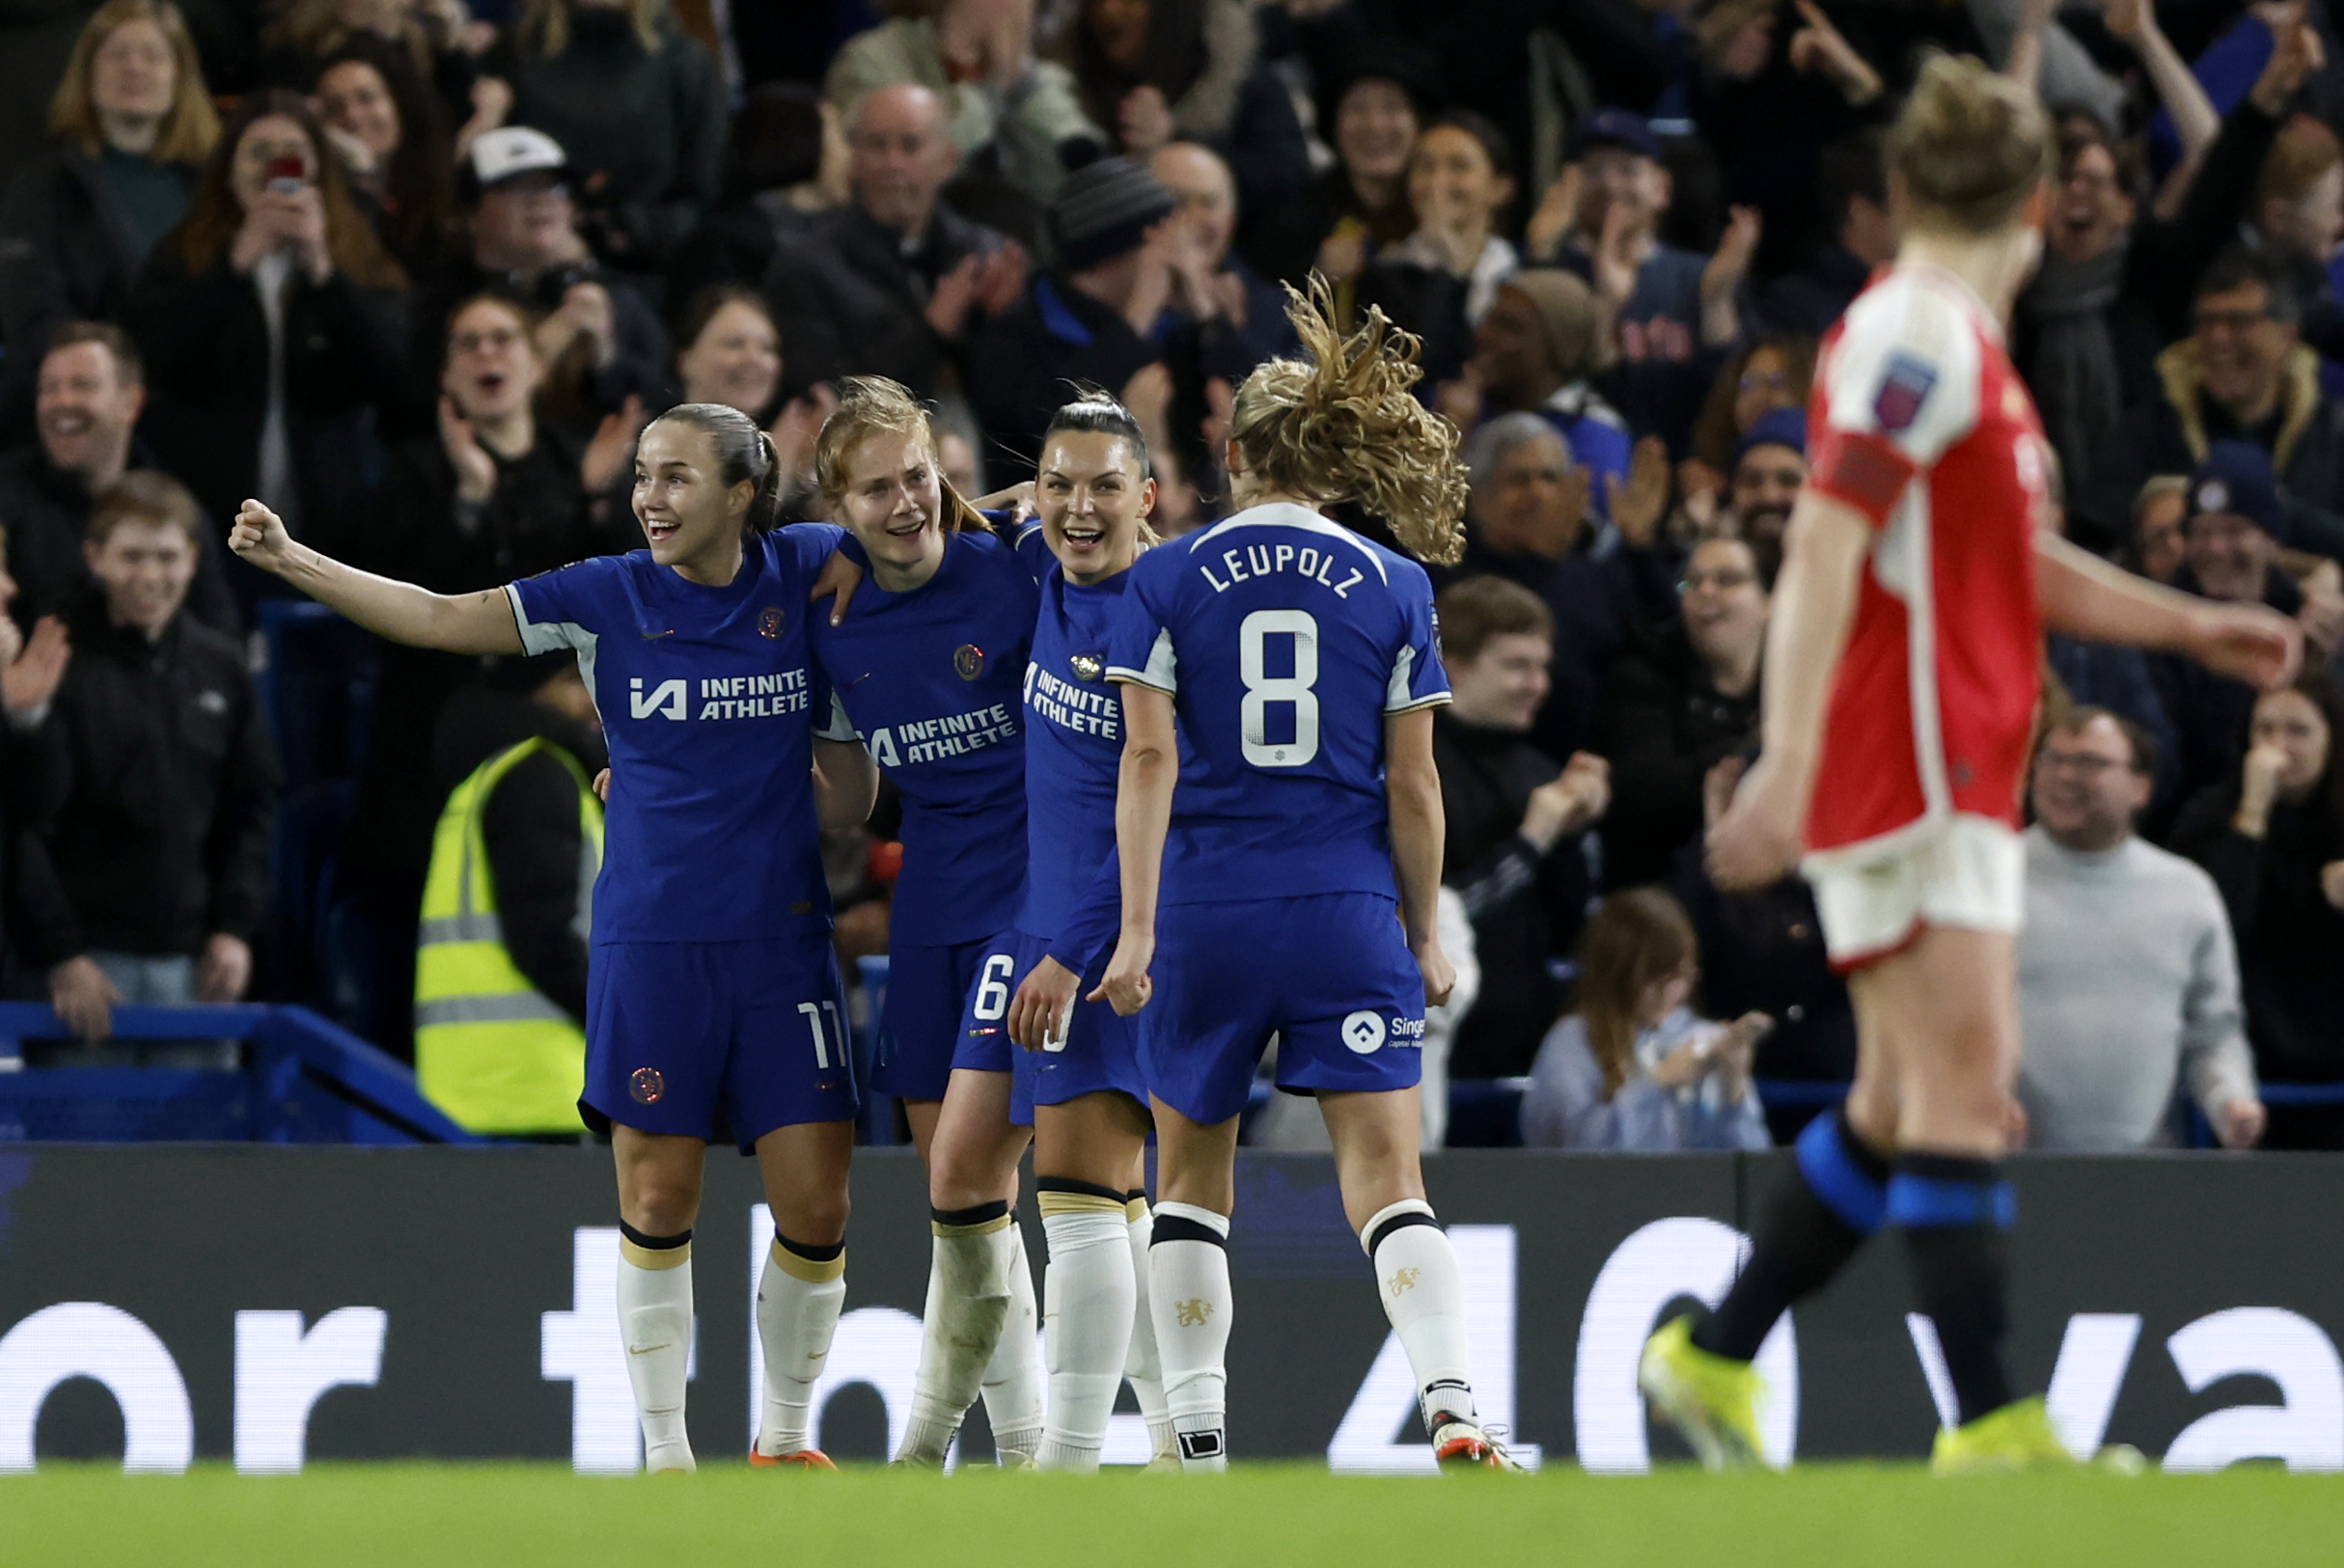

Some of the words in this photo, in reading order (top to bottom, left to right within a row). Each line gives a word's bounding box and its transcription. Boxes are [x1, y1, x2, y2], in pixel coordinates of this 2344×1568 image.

[1200, 543, 1364, 599] LEUPOLZ
[699, 690, 808, 721] ATHLETE
[702, 668, 807, 699] INFINITE
[1037, 669, 1118, 719] INFINITE
[1239, 610, 1319, 767] 8
[898, 702, 1009, 744] INFINITE
[1034, 692, 1117, 740] ATHLETE
[908, 721, 1017, 764] ATHLETE
[974, 953, 1014, 1021] 6
[797, 1000, 846, 1069] 11
